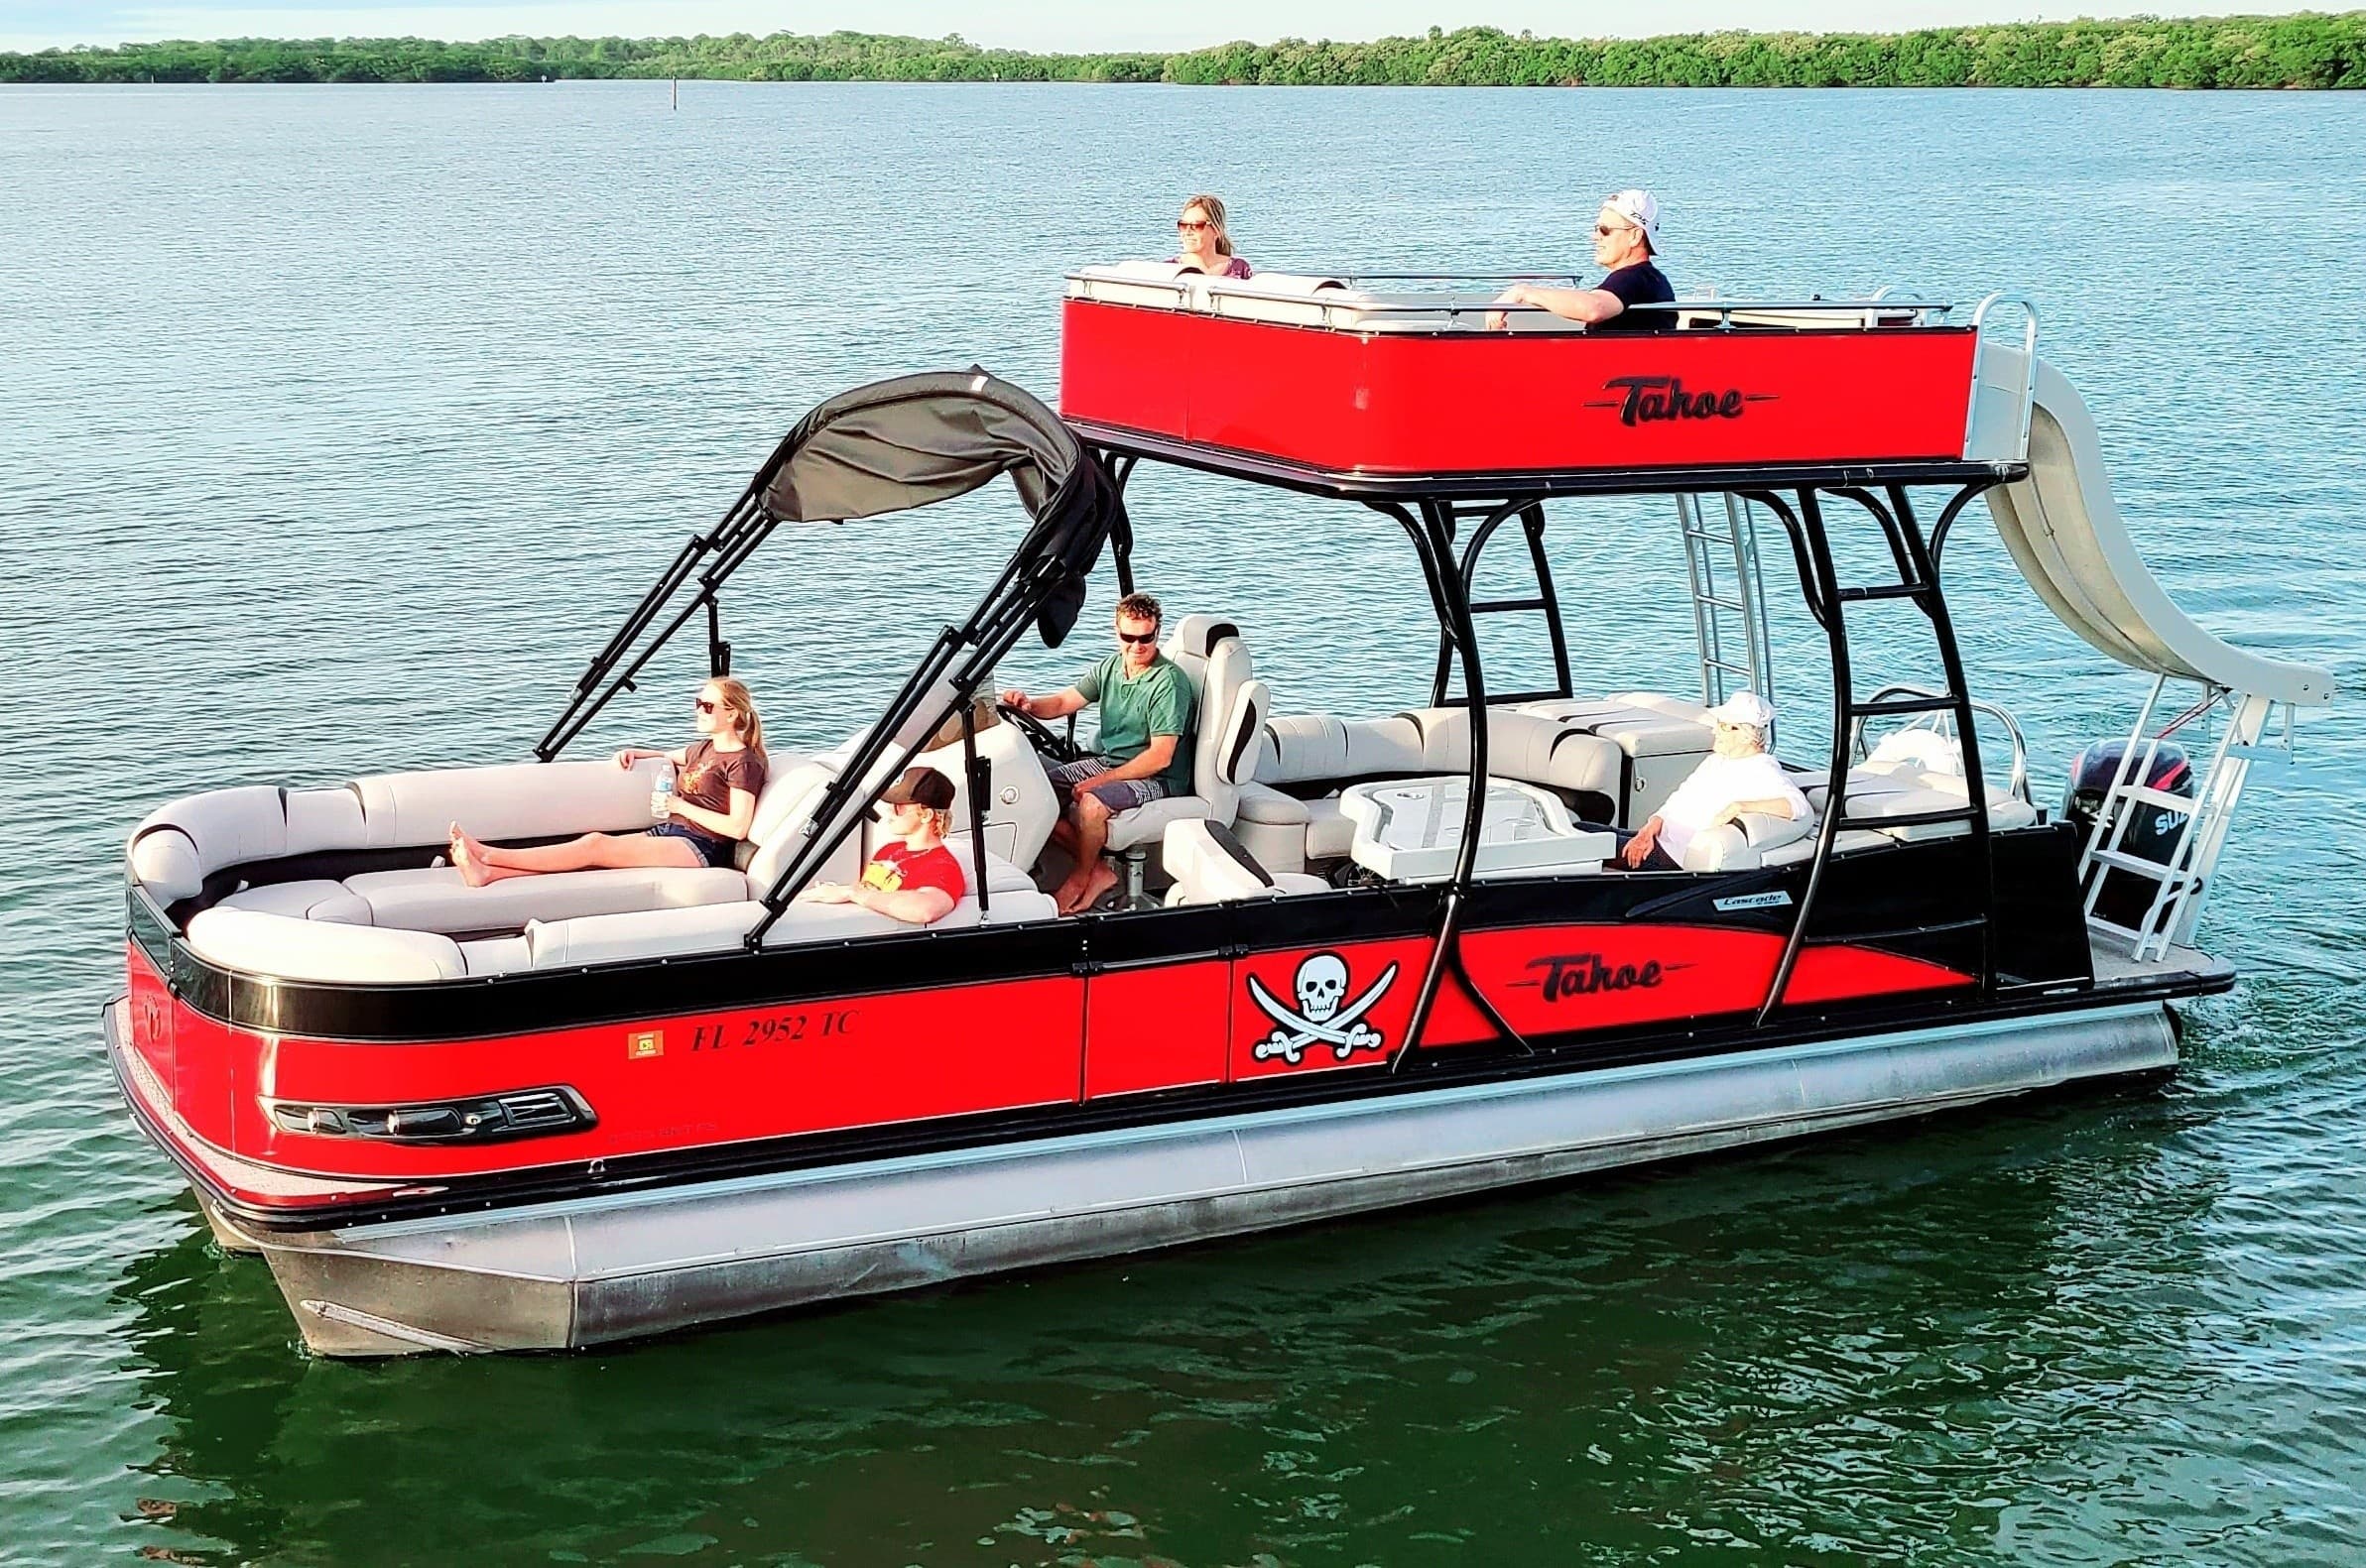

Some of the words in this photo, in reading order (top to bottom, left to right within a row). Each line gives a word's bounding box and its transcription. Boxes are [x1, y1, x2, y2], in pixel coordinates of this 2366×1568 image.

[1601, 375, 1745, 427] Tahoe
[1723, 895, 1782, 905] Cascade
[1526, 953, 1663, 1002] Tahoe
[691, 1024, 729, 1051] FL
[743, 1016, 807, 1045] 2952
